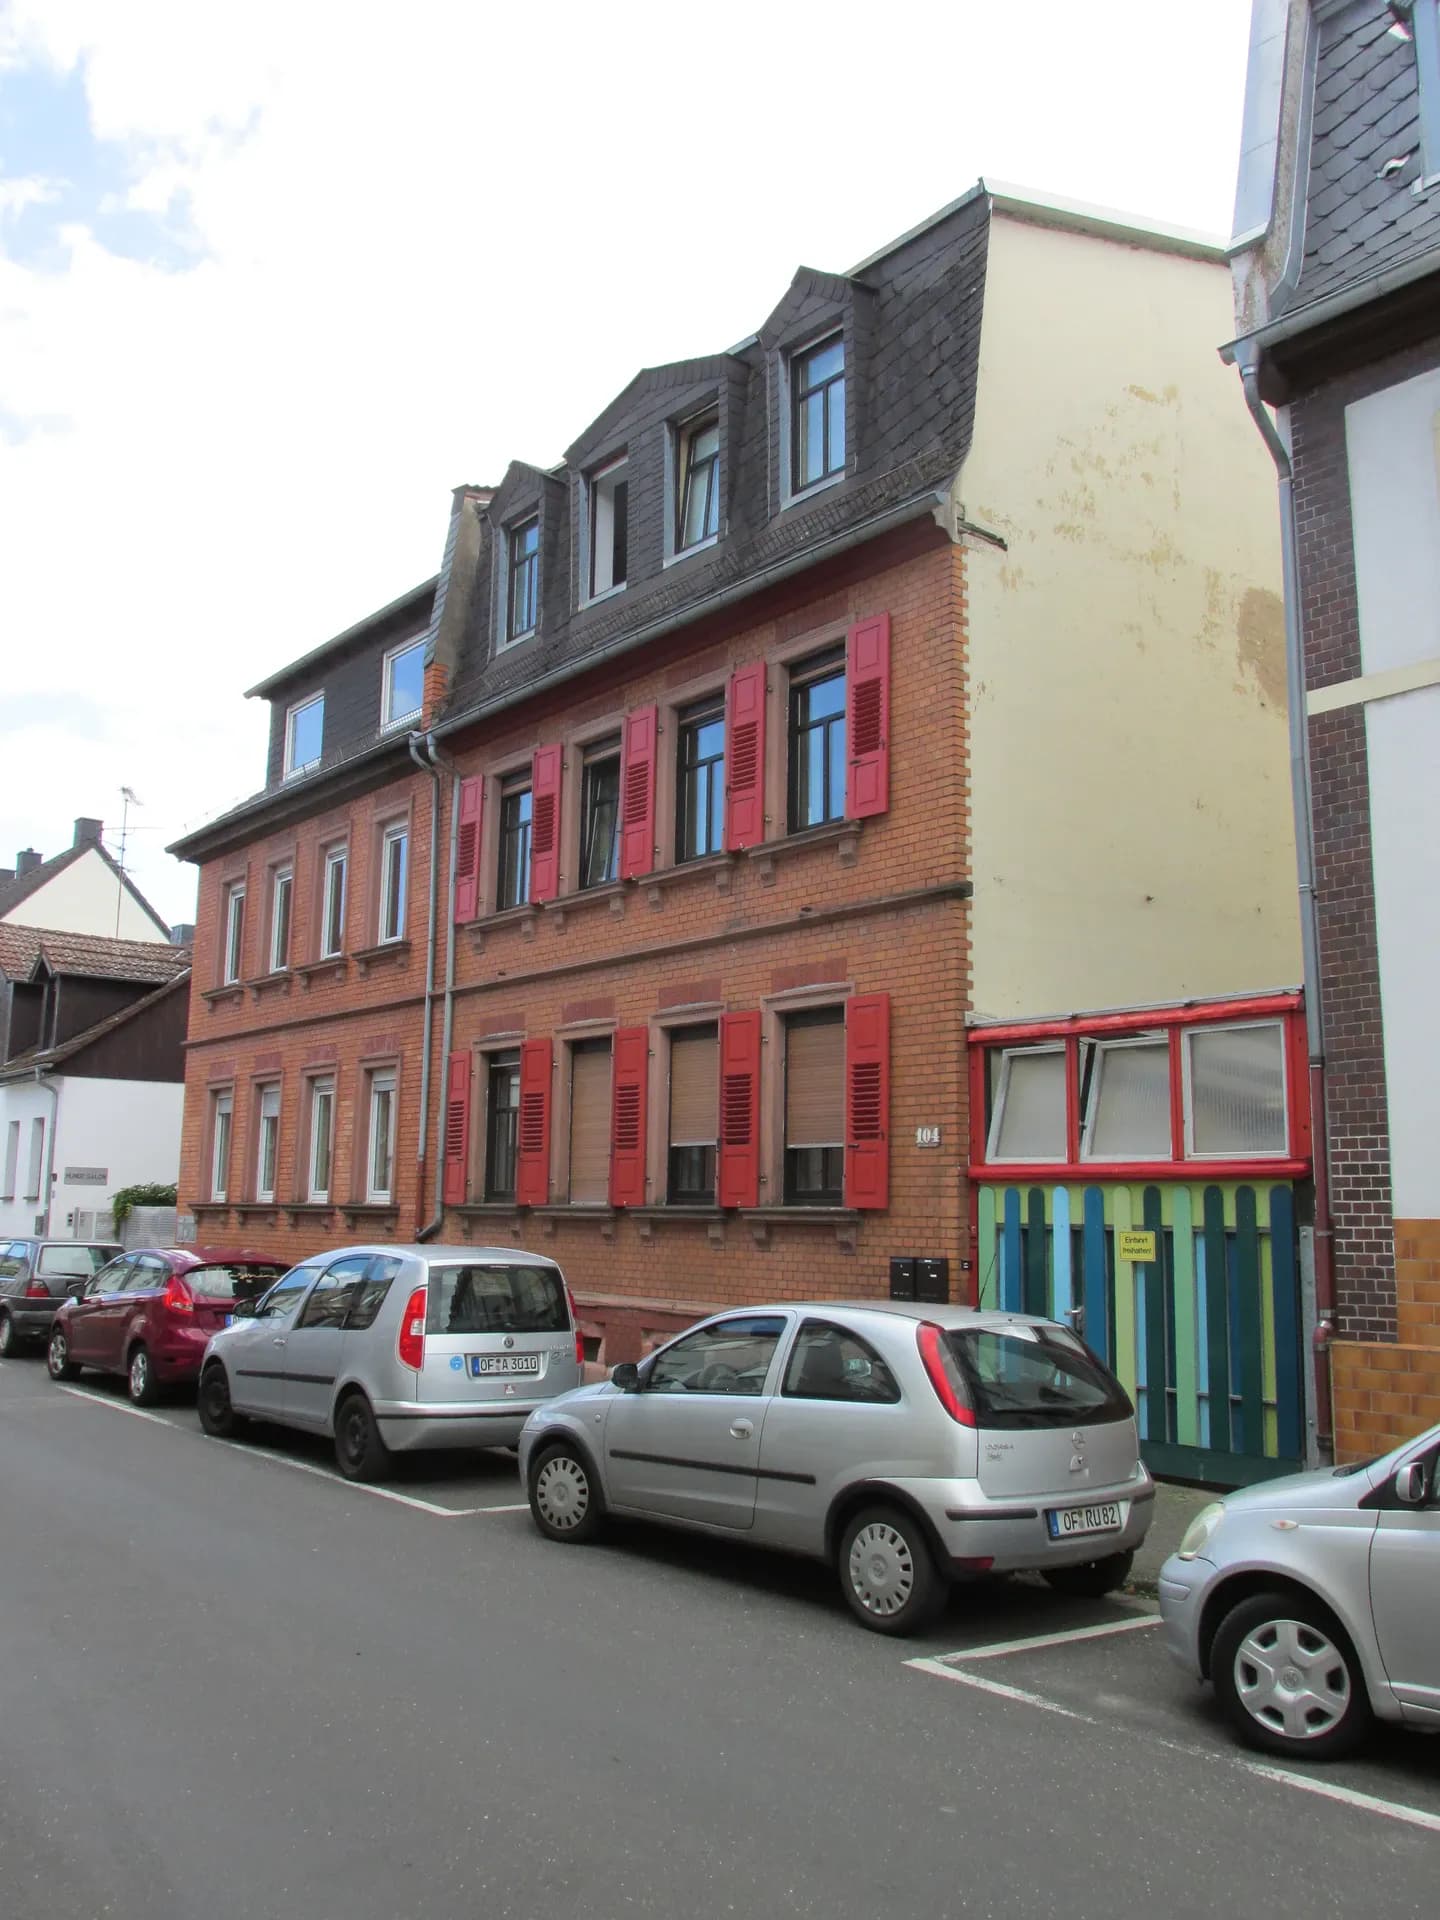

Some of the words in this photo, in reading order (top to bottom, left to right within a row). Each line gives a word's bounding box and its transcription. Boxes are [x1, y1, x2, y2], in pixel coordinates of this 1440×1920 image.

[916, 1127, 940, 1144] 104
[480, 1358, 495, 1371] OF
[502, 1358, 509, 1370] A
[512, 1357, 537, 1370] 3010
[1063, 1511, 1079, 1530] OF
